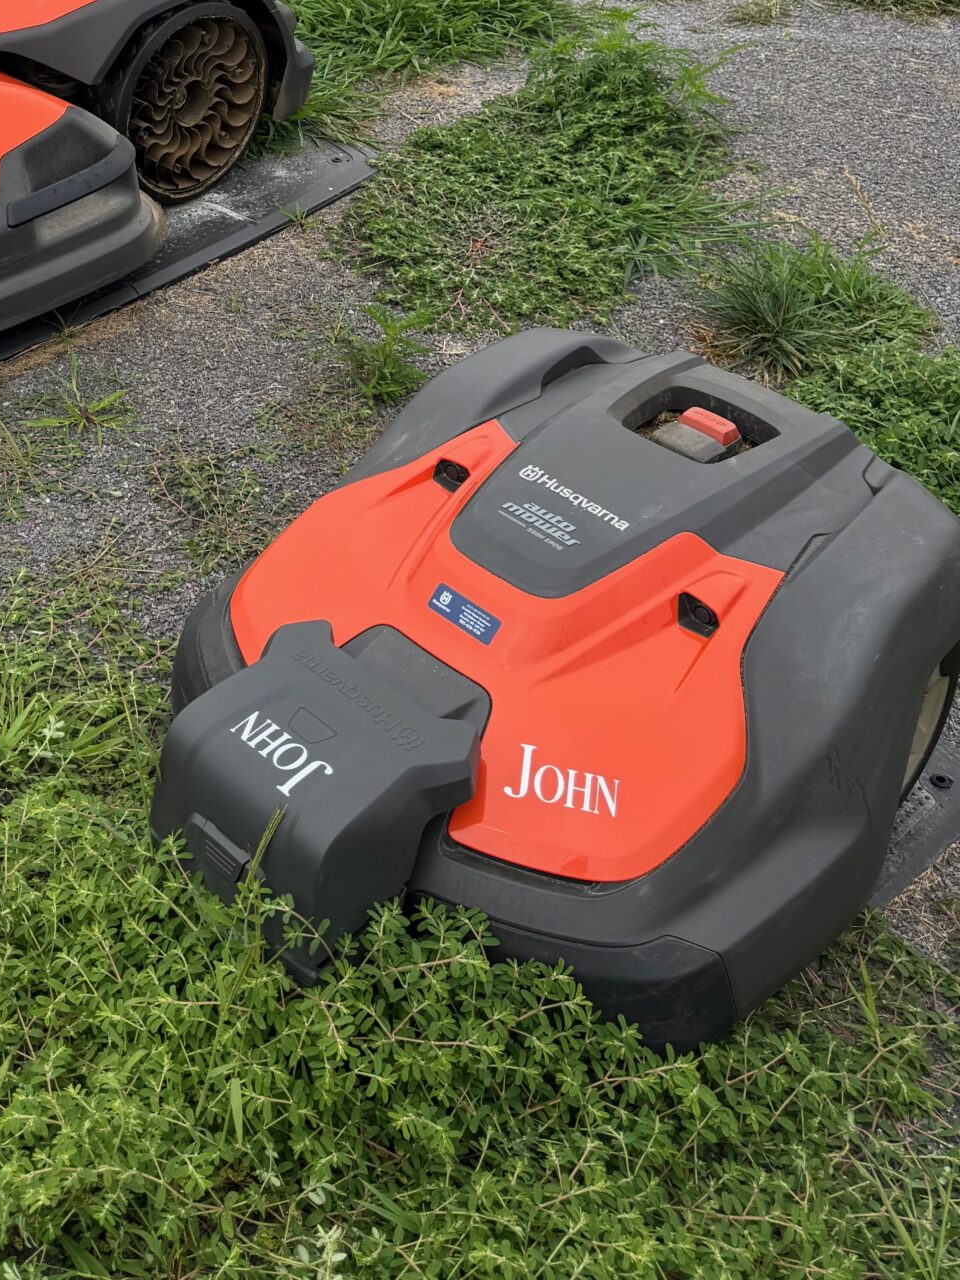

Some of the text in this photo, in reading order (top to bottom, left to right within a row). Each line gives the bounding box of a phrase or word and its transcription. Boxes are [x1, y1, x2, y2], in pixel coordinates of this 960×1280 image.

[501, 501, 581, 546] mower
[522, 502, 577, 532] auto
[537, 474, 630, 531] Husqvarna
[291, 650, 402, 733] Husqvarna
[229, 710, 334, 797] JOHN
[503, 743, 620, 818] JOHN
